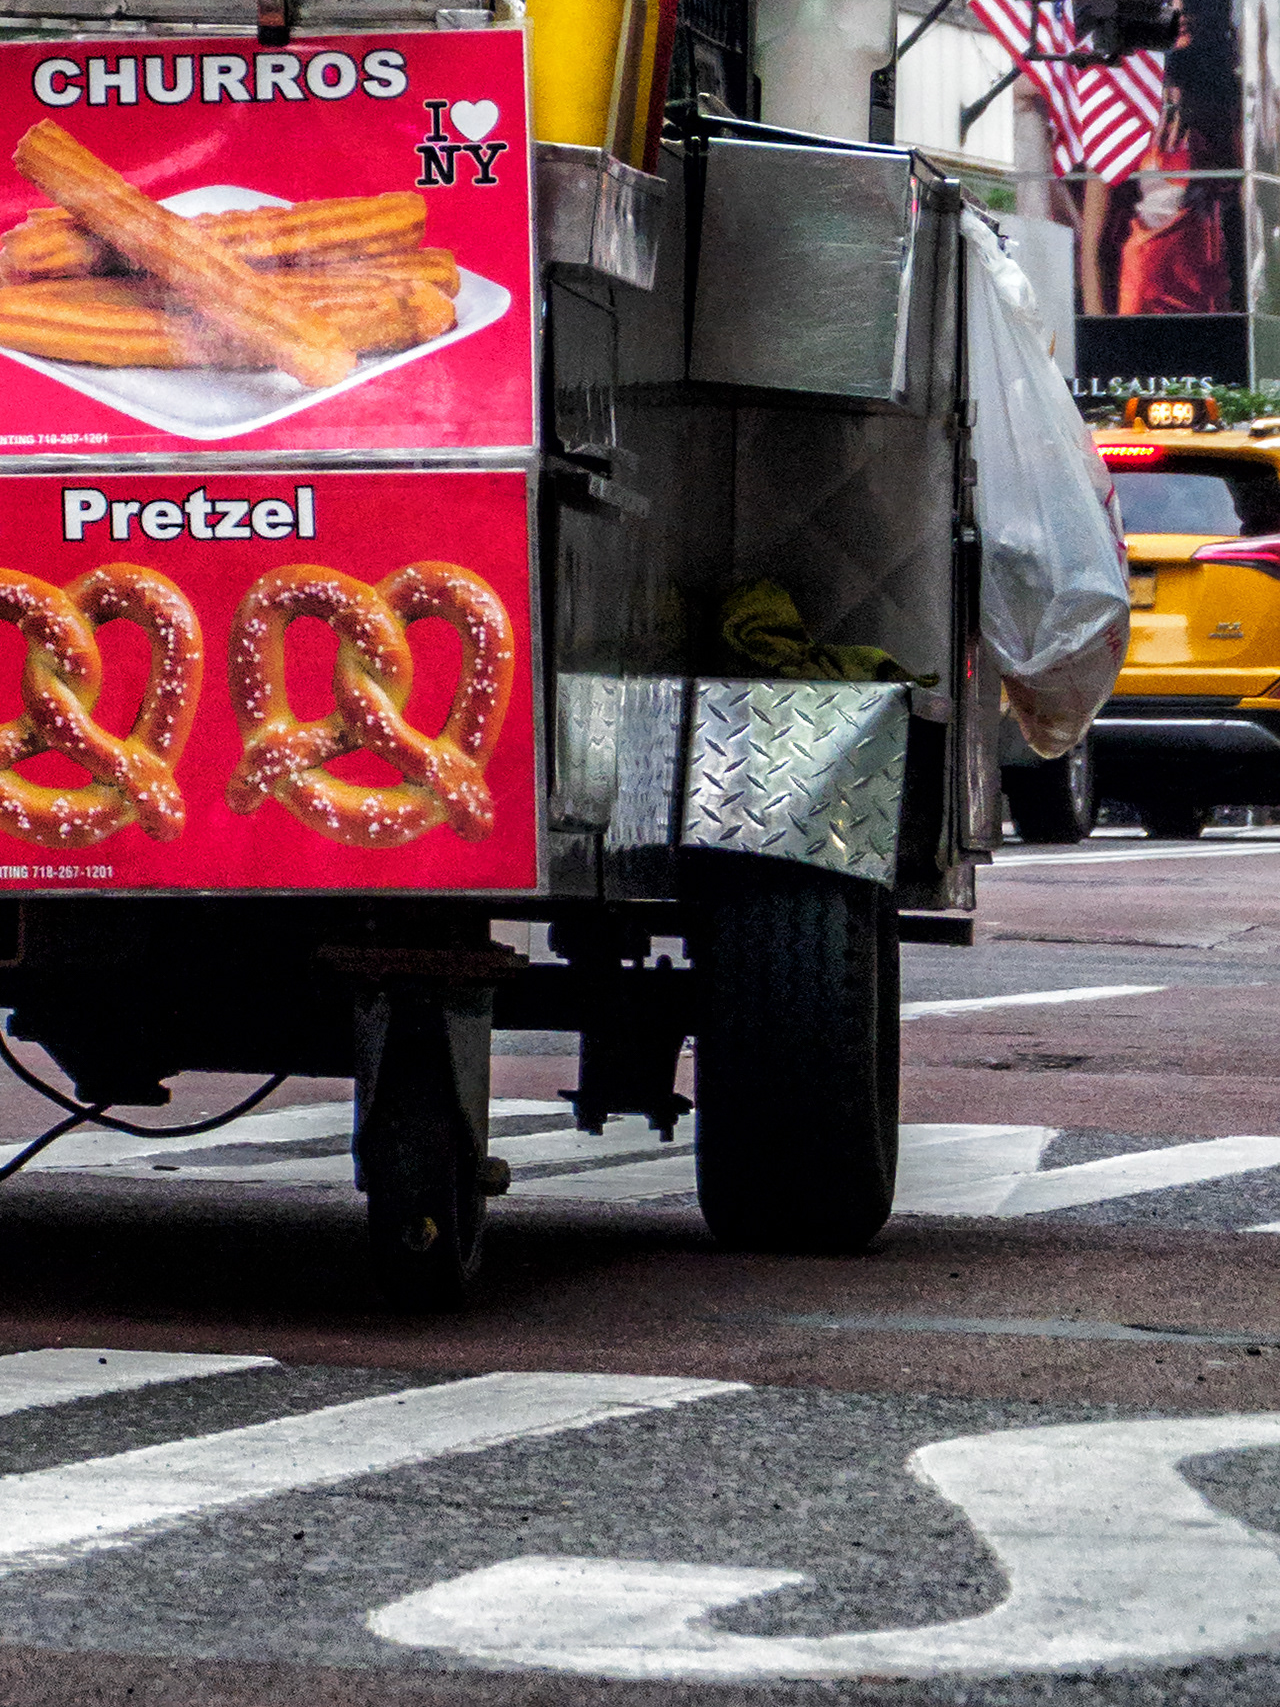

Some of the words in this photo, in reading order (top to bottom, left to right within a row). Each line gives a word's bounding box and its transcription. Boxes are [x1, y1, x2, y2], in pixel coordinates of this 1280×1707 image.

[33, 50, 409, 108] CHURROS
[423, 101, 448, 143] I
[416, 143, 507, 187] NY
[1073, 376, 1213, 397] LLSAINTS
[61, 485, 316, 543] Pretzel
[31, 864, 112, 878] 718-267-1201
